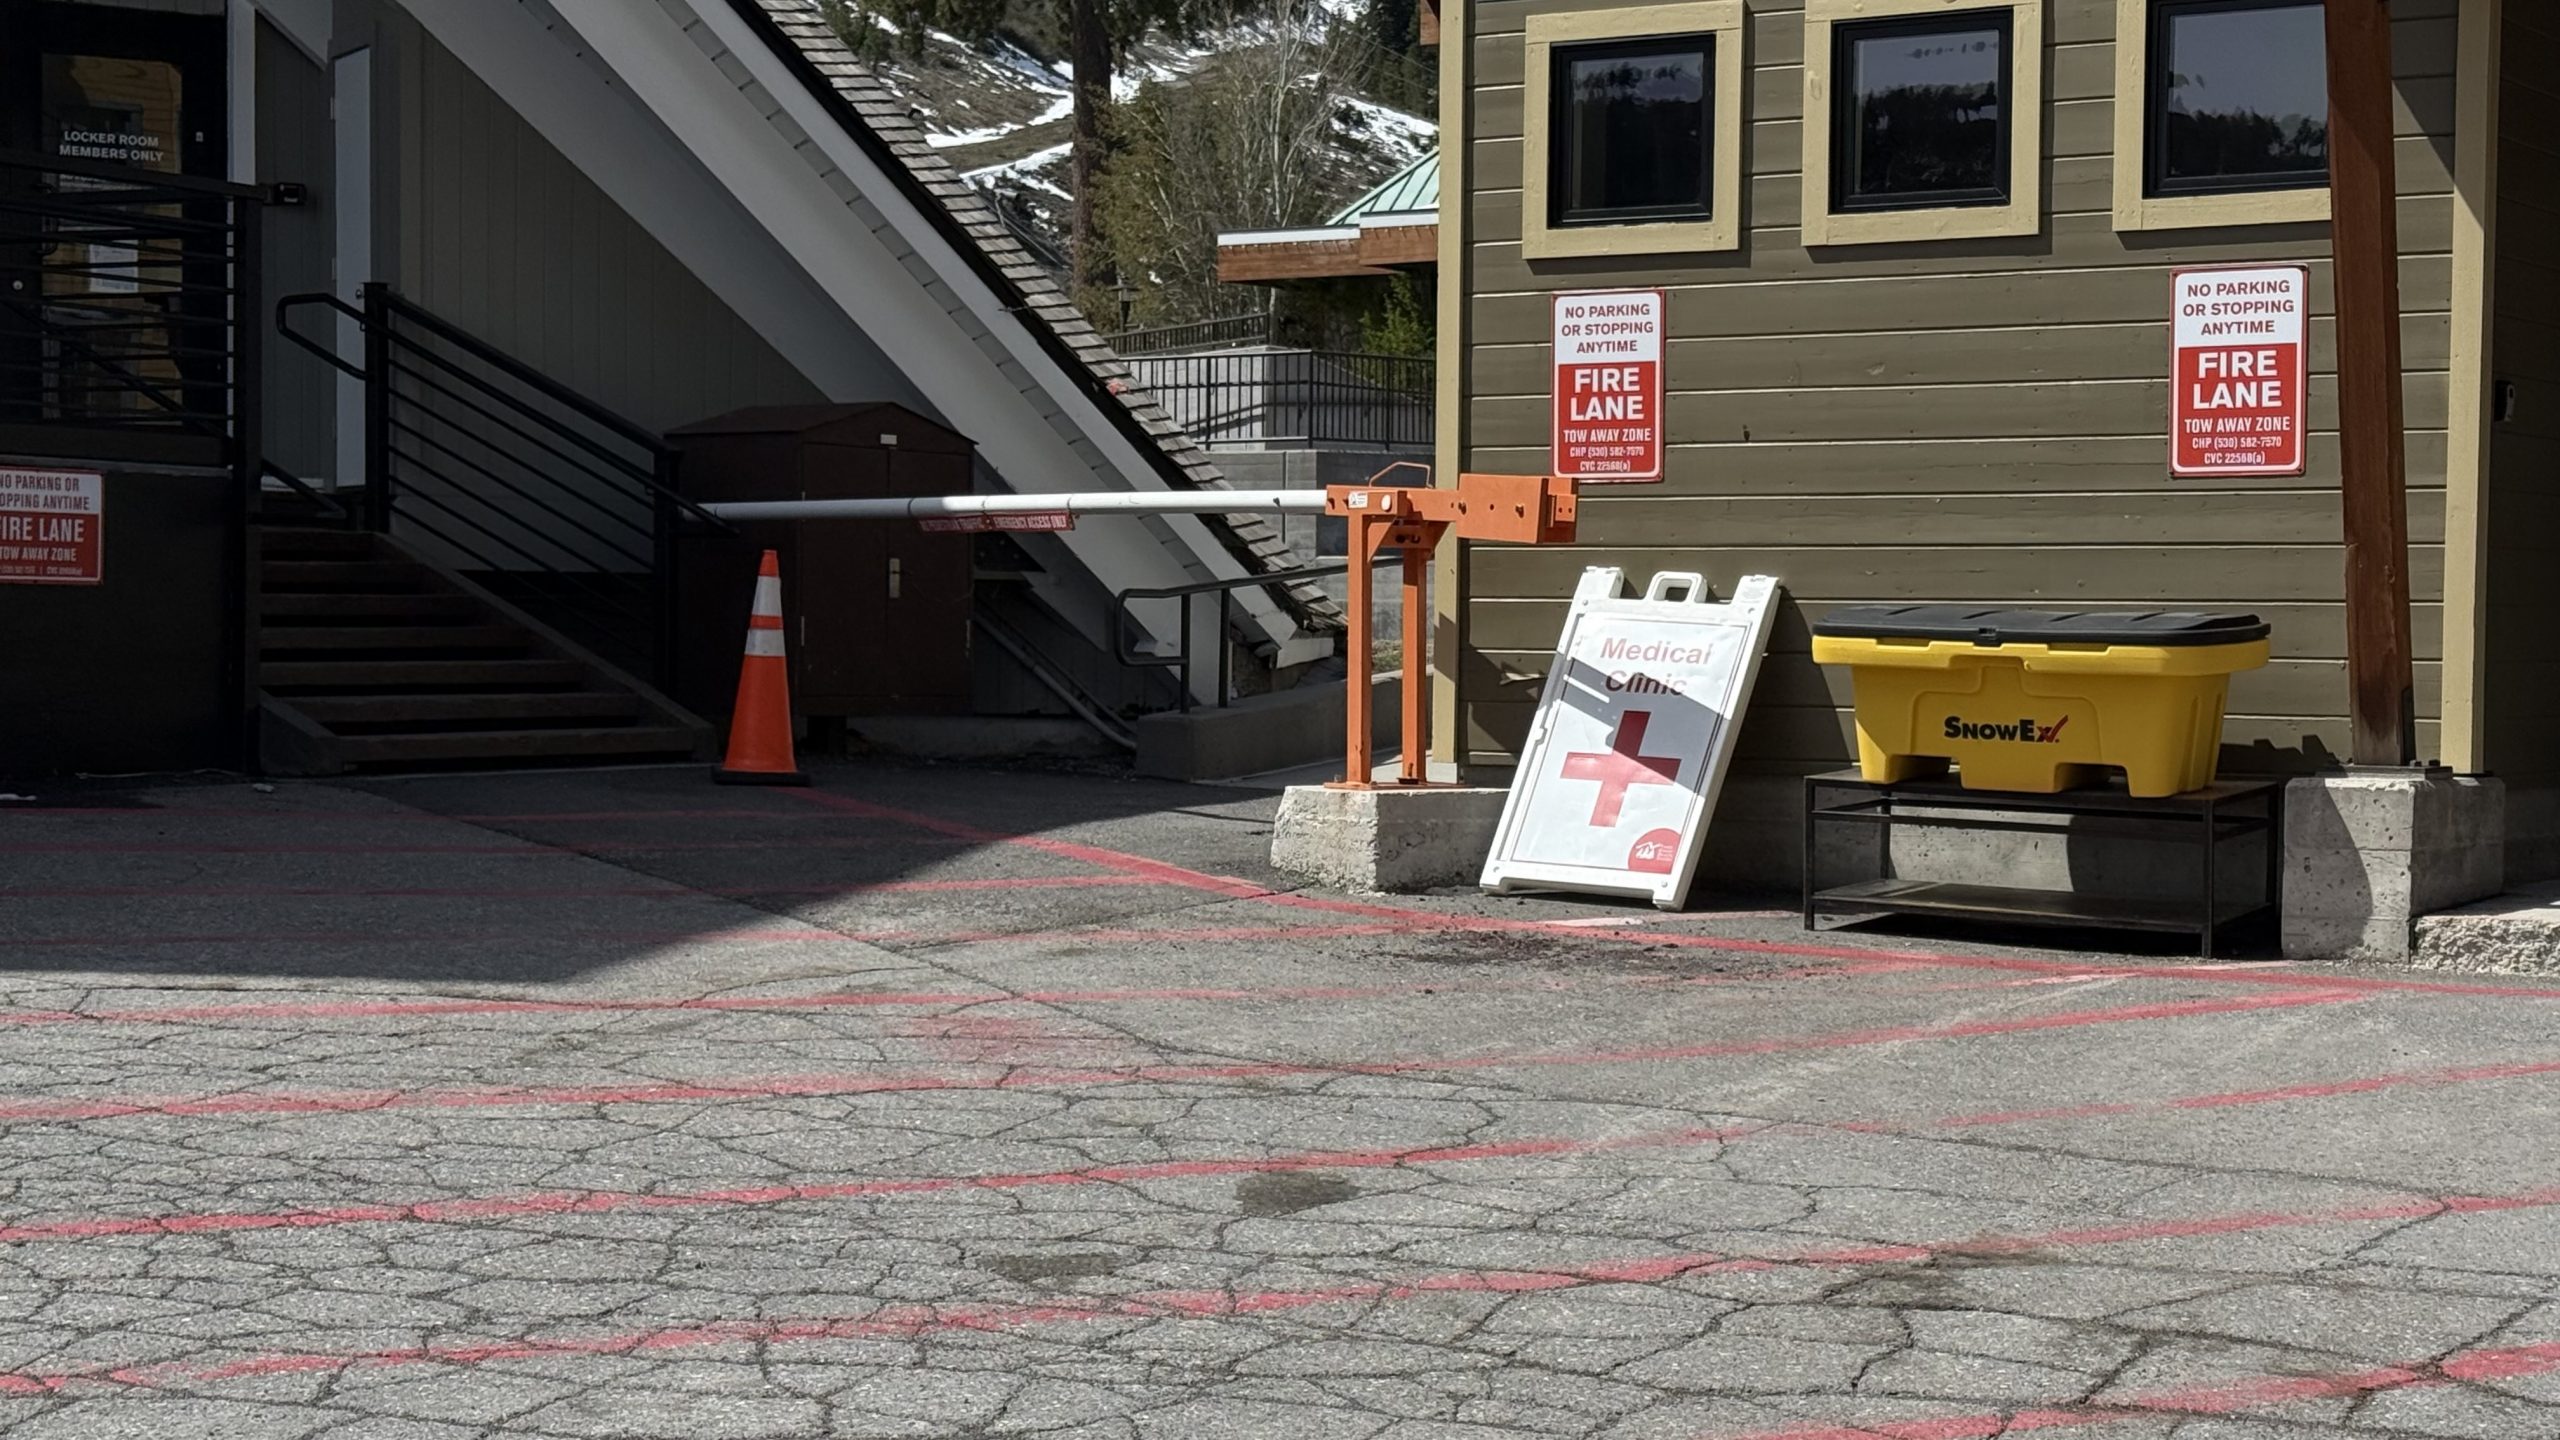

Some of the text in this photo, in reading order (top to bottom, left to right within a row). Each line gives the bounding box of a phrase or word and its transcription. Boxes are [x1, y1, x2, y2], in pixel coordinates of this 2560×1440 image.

[64, 130, 160, 147] LOCKER ROOM
[59, 144, 164, 162] MEMBERS ONLY
[2187, 280, 2290, 298] NO PARKING
[1565, 303, 1650, 319] NO PARKING
[2183, 300, 2294, 317] OR STOPPING
[1561, 321, 1654, 337] OR STOPPING
[2201, 320, 2275, 335] ANYTIME
[1576, 340, 1638, 354] ANYTIME
[2198, 350, 2278, 379] FIRE
[1574, 367, 1641, 394] FIRE
[2192, 380, 2283, 410] LANE
[1570, 395, 1645, 422] LANE
[2184, 416, 2291, 434] TOW AWAY ZONE
[1563, 427, 1652, 443] TOW AWAY ZONE
[2192, 437, 2212, 449] CHP
[2214, 436, 2238, 451] (530)
[1569, 447, 1587, 458] CHP
[2204, 453, 2223, 465] CVC
[1580, 461, 1596, 472] CVC
[15, 475, 61, 491] PARKING
[65, 477, 80, 492] OR
[0, 493, 90, 511] OPPING ANYTIME
[0, 515, 84, 542] IRE LANE
[22, 546, 49, 561] AWAY
[51, 547, 77, 562] ZONE
[1600, 638, 1714, 665] Medical
[1605, 670, 1688, 696] Clinic
